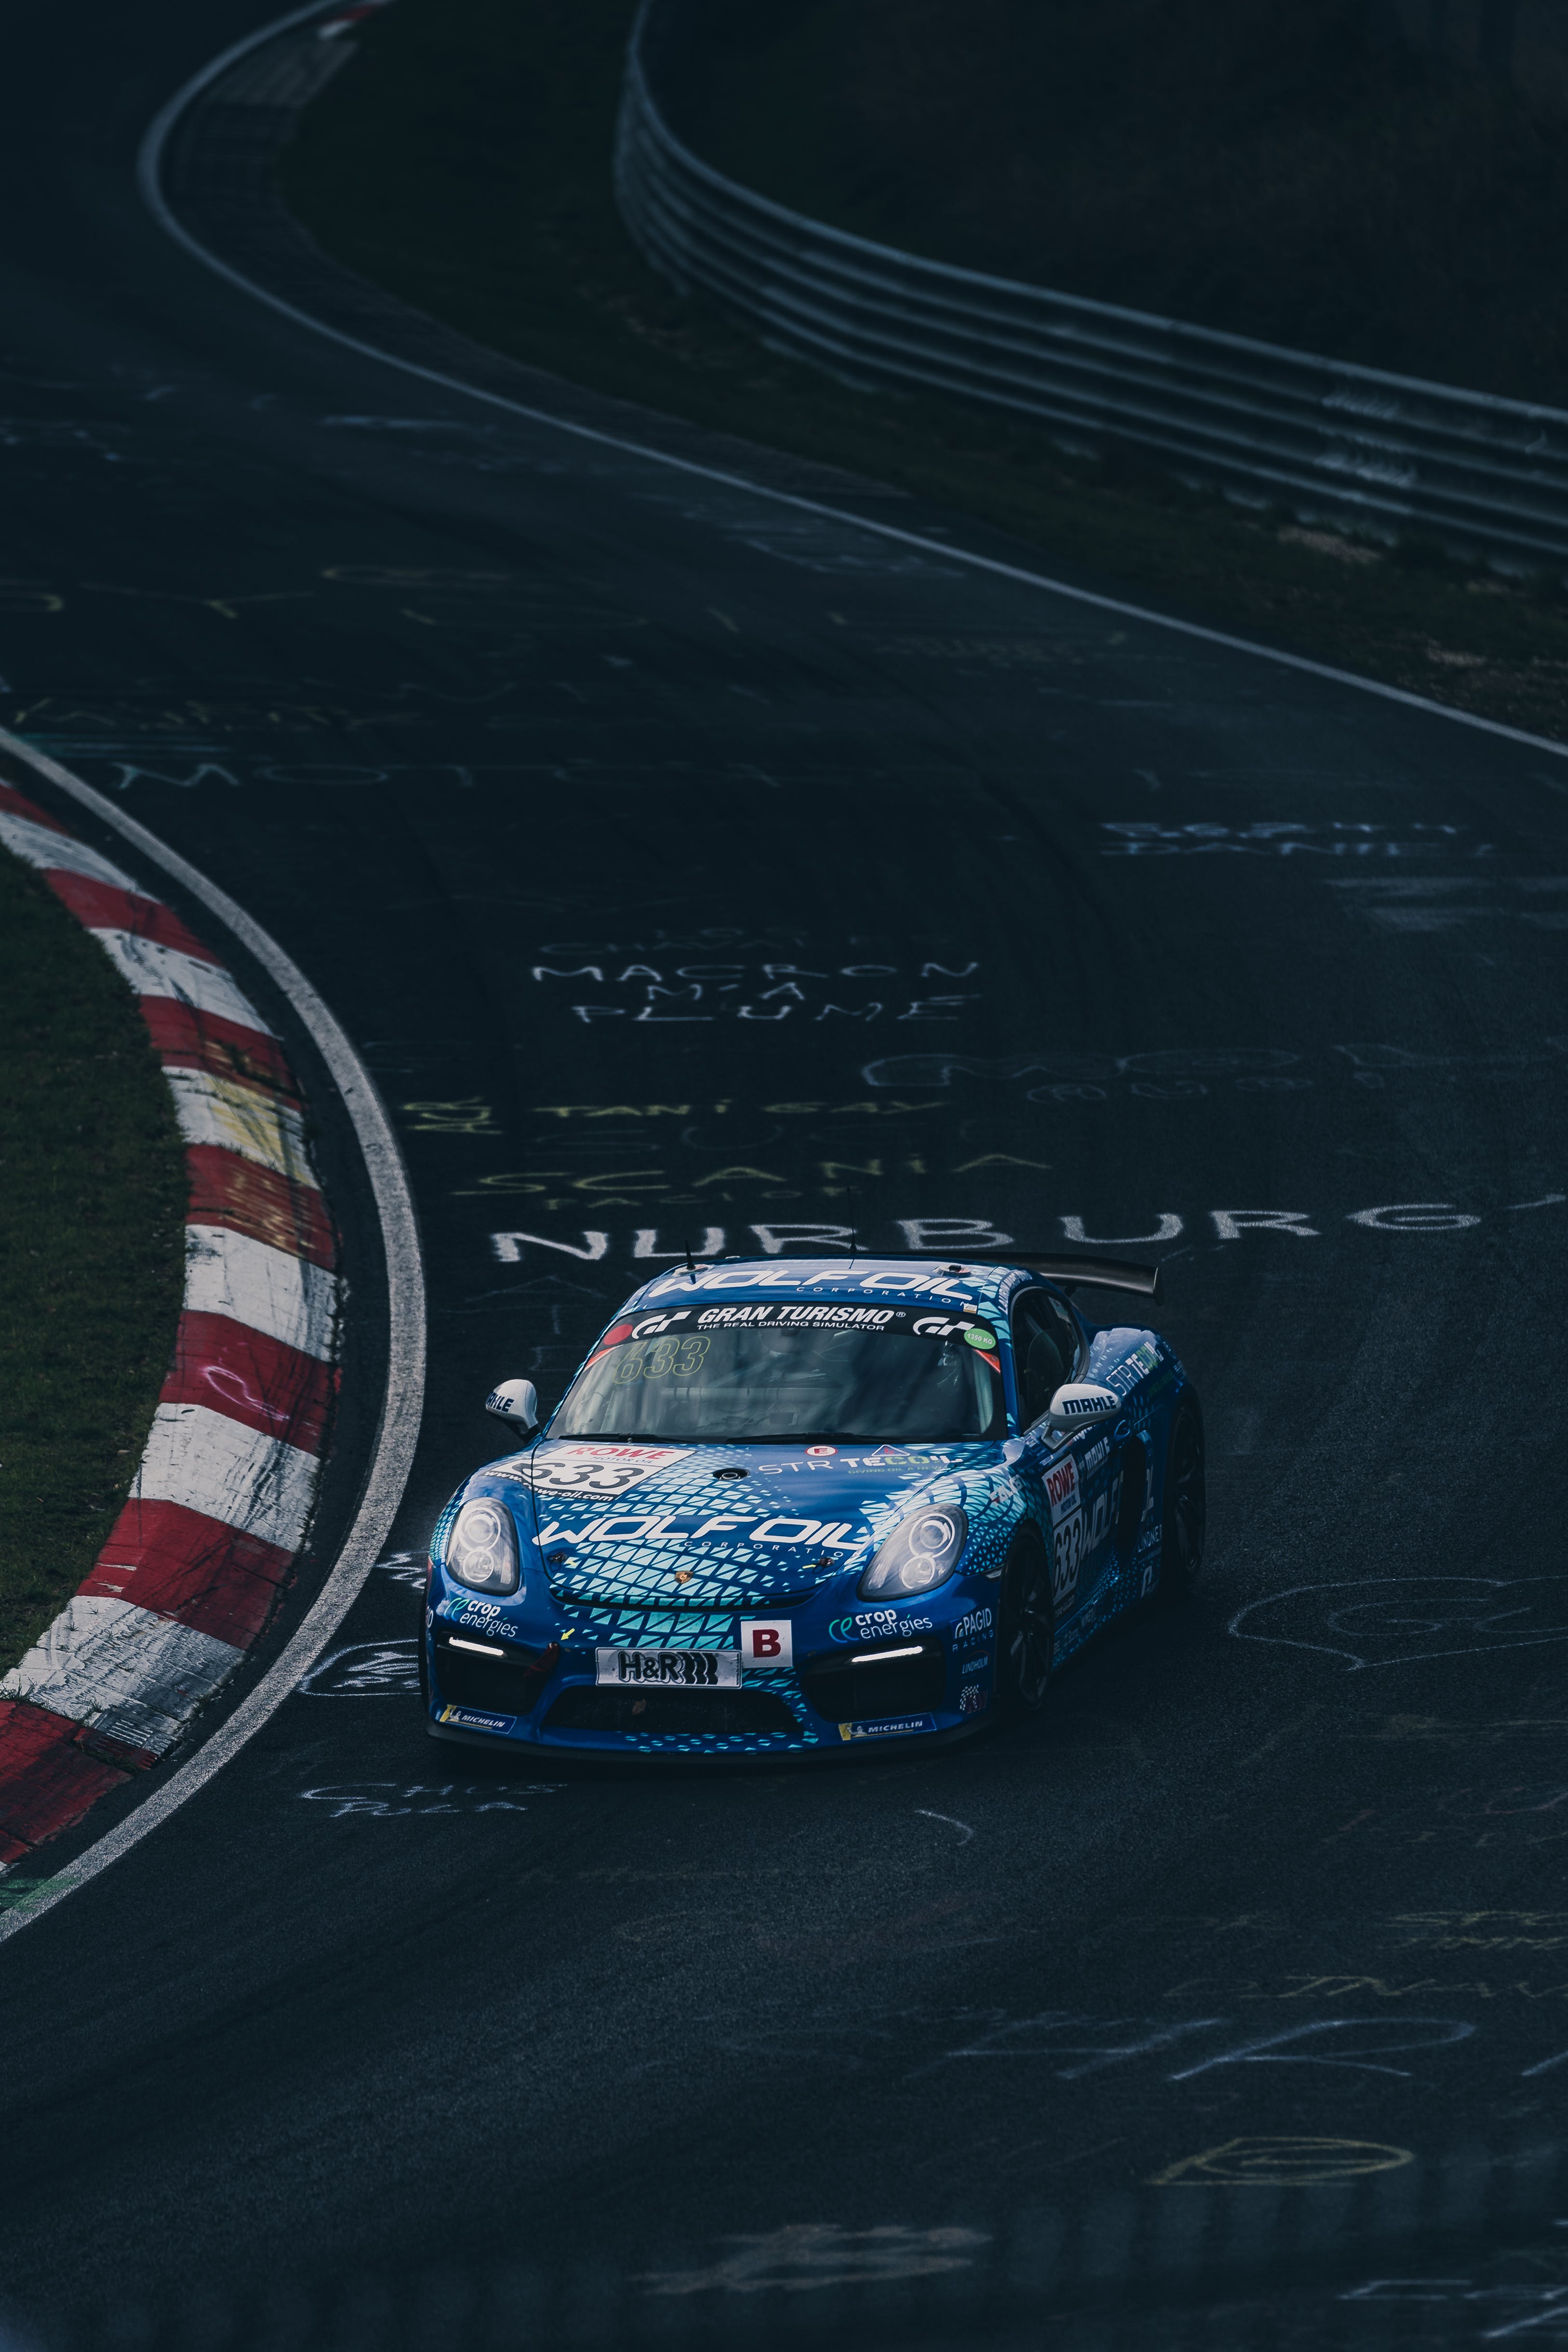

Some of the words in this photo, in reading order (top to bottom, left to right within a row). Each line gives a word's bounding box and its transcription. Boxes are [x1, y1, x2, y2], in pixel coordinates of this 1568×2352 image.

[532, 962, 978, 982] MACRON
[648, 1269, 972, 1301] WOLFOIL
[697, 1308, 765, 1323] GRAN
[811, 1321, 885, 1331] SIMULATOR
[612, 1336, 711, 1385] 633
[1062, 1395, 1116, 1415] MAHLE
[566, 1447, 675, 1460] ROWE
[512, 1462, 645, 1489] 633
[758, 1460, 833, 1475] STR
[1046, 1462, 1076, 1507] ROWE
[532, 1515, 866, 1550] WOLFOIL
[467, 1598, 501, 1618] crop
[855, 1608, 897, 1626] crop
[459, 1611, 518, 1637] energies
[860, 1614, 933, 1639] energies
[963, 1608, 992, 1636] PAGID
[752, 1629, 782, 1658] B
[462, 1714, 505, 1727] MICHELIN
[868, 1720, 923, 1733] MICHELIN
